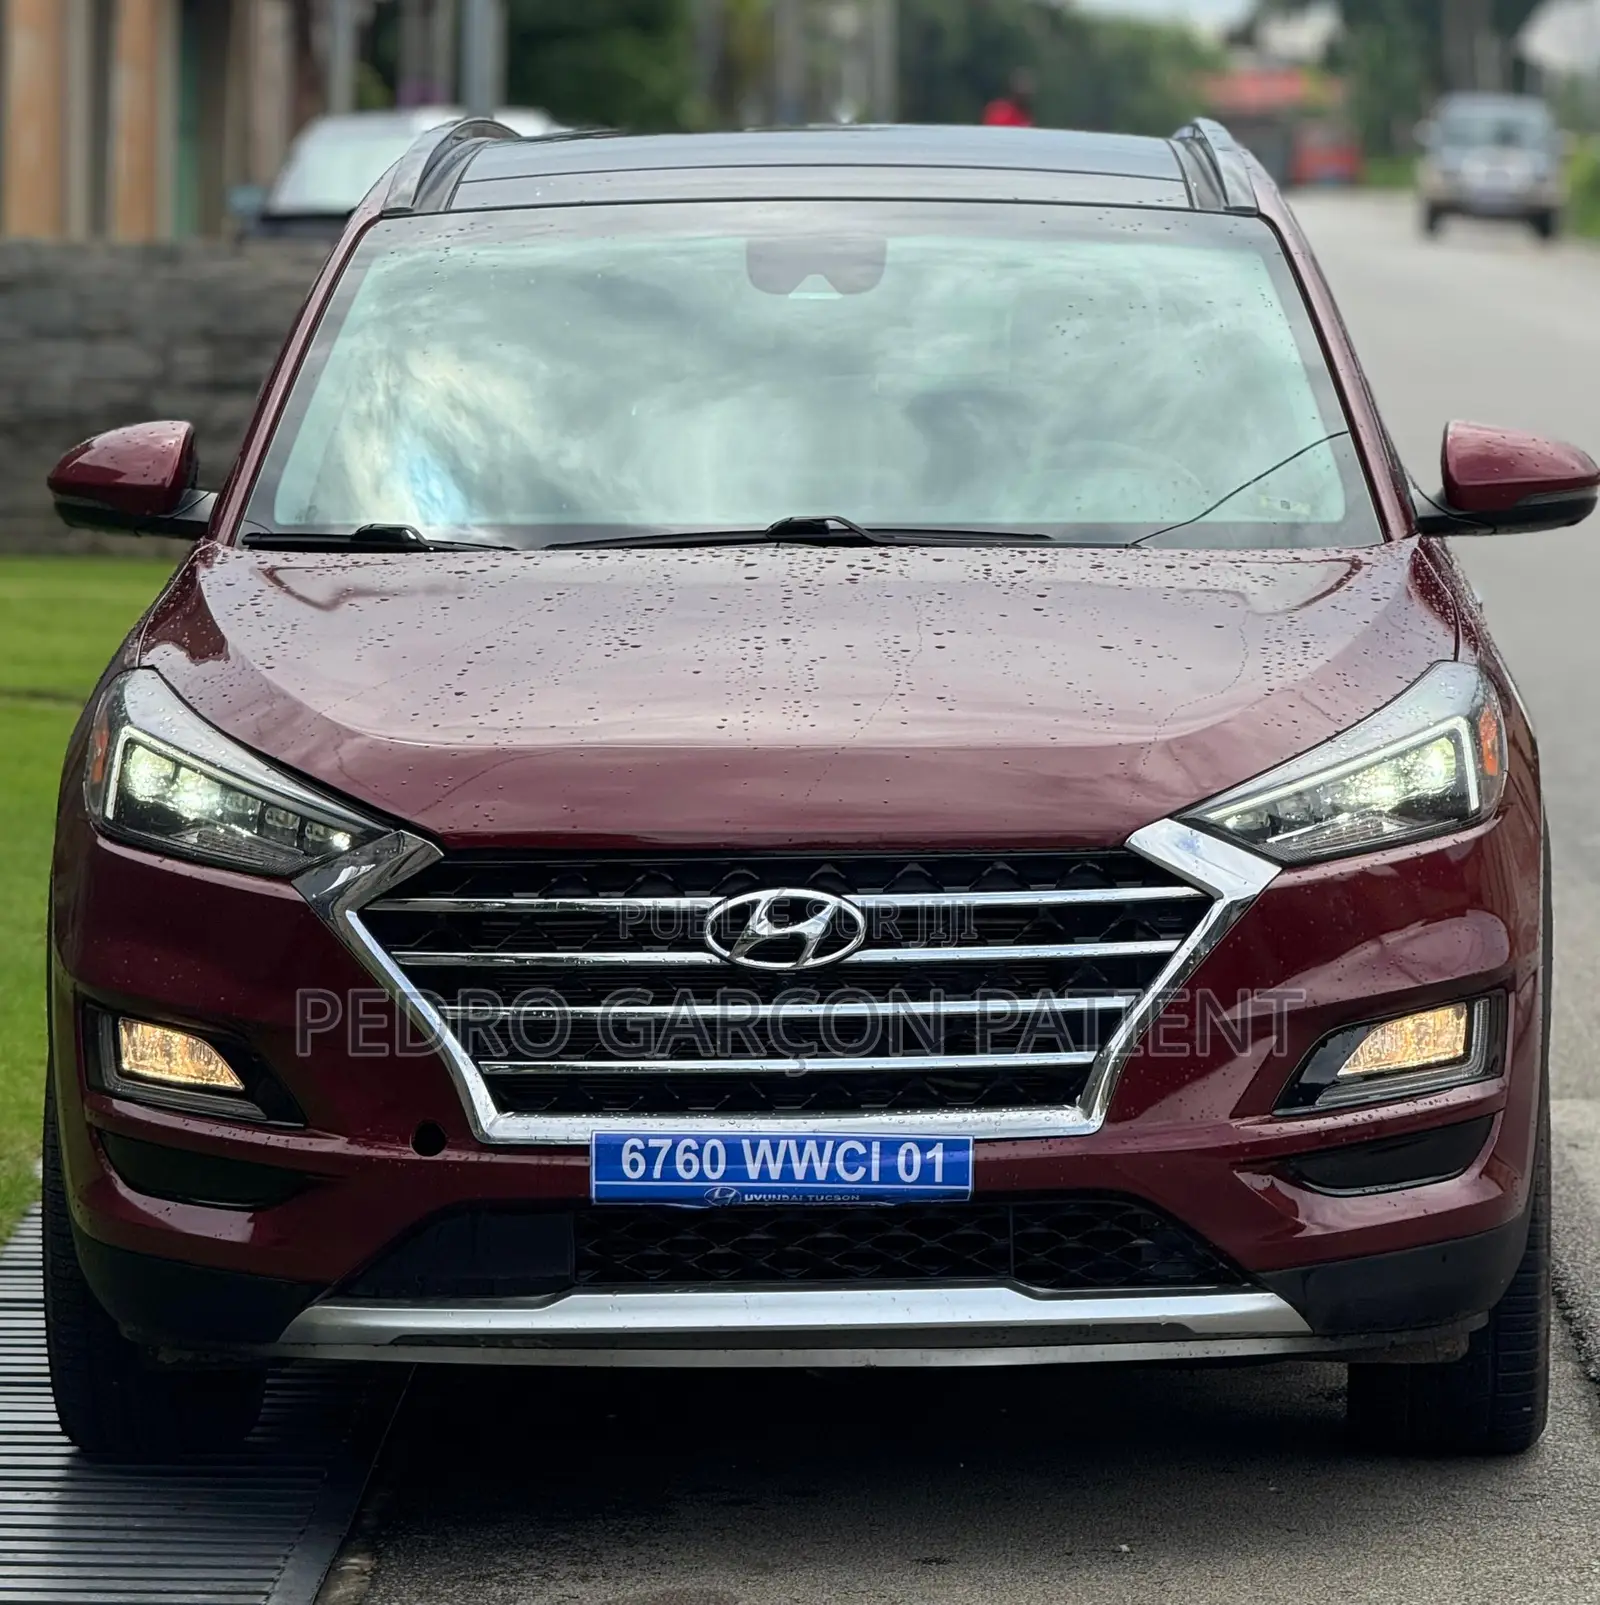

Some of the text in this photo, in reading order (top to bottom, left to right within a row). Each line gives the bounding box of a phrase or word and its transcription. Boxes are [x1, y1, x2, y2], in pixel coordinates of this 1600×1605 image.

[620, 1137, 944, 1183] 6760 WWCI 01
